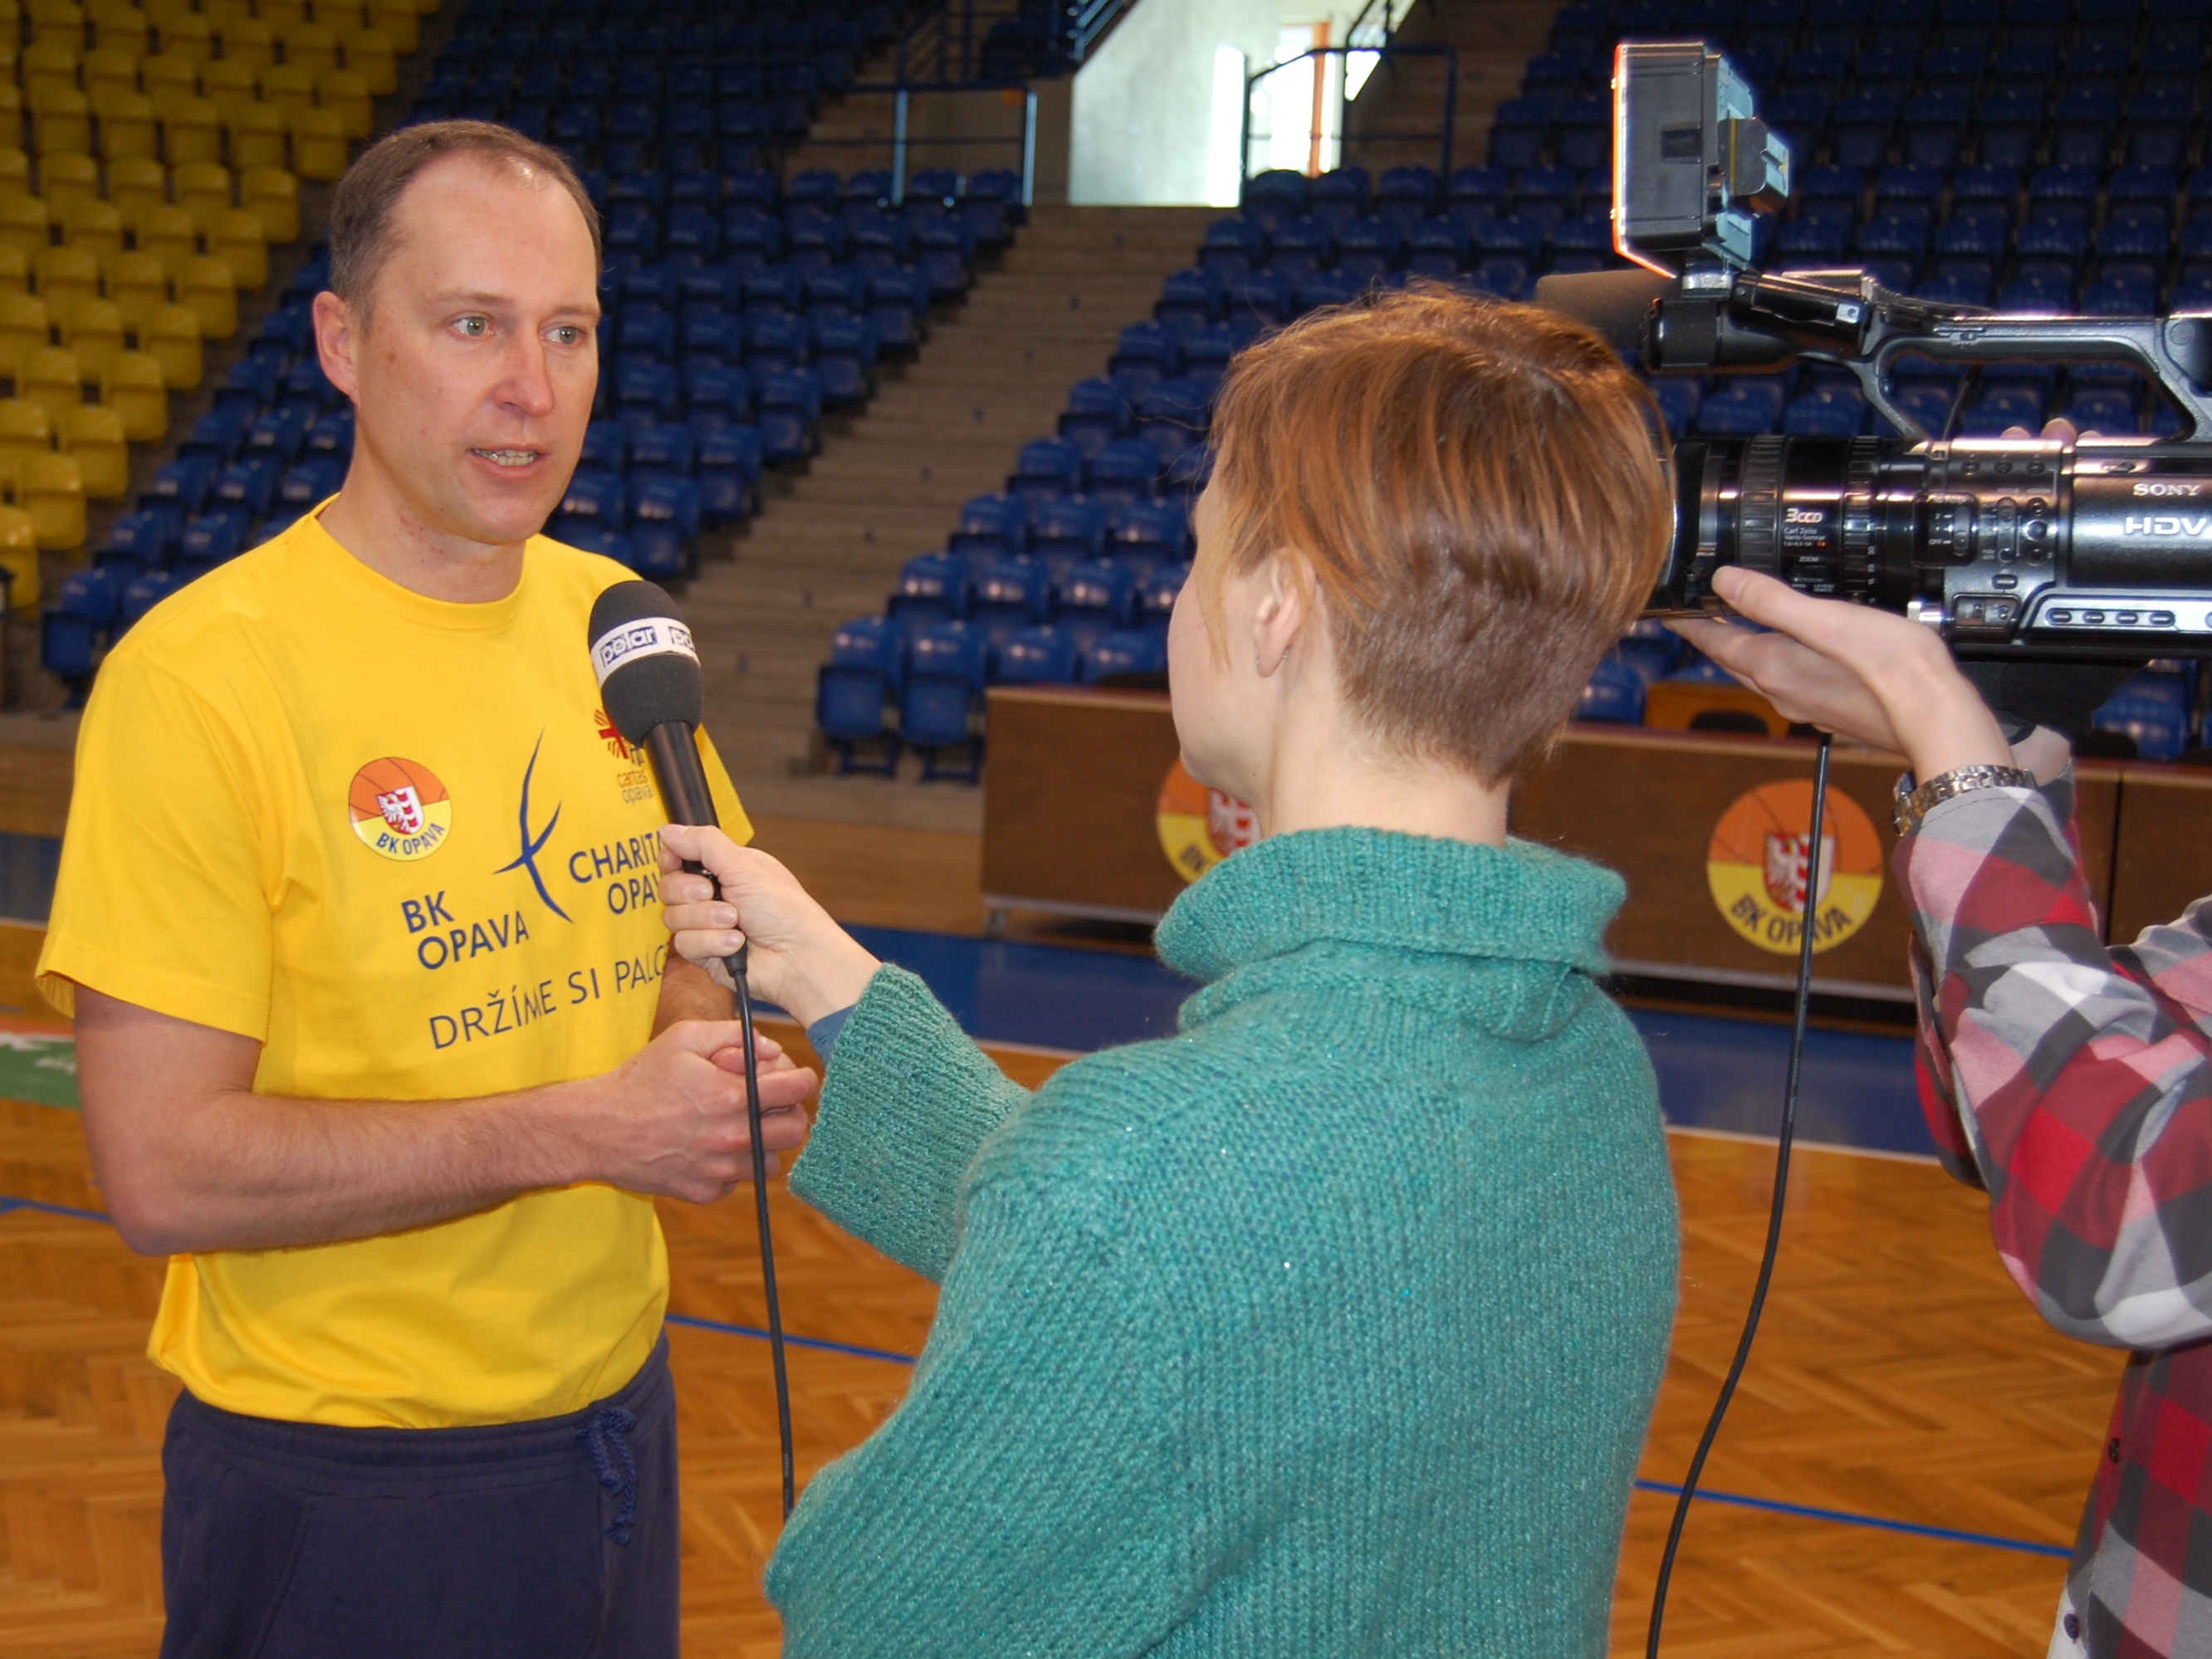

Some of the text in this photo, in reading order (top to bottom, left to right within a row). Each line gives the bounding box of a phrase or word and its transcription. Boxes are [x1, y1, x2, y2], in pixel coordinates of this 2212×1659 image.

[2133, 483, 2201, 496] SONY
[1784, 507, 1823, 523] 3CCD
[2126, 516, 2207, 536] HDV
[601, 628, 655, 668] polar
[376, 822, 446, 855] BK OPAVA
[402, 890, 455, 933] BK
[1732, 894, 1766, 932] BK
[418, 910, 530, 970] OPAVA
[429, 979, 557, 1050] DRŽÍME
[568, 969, 600, 1005] SI
